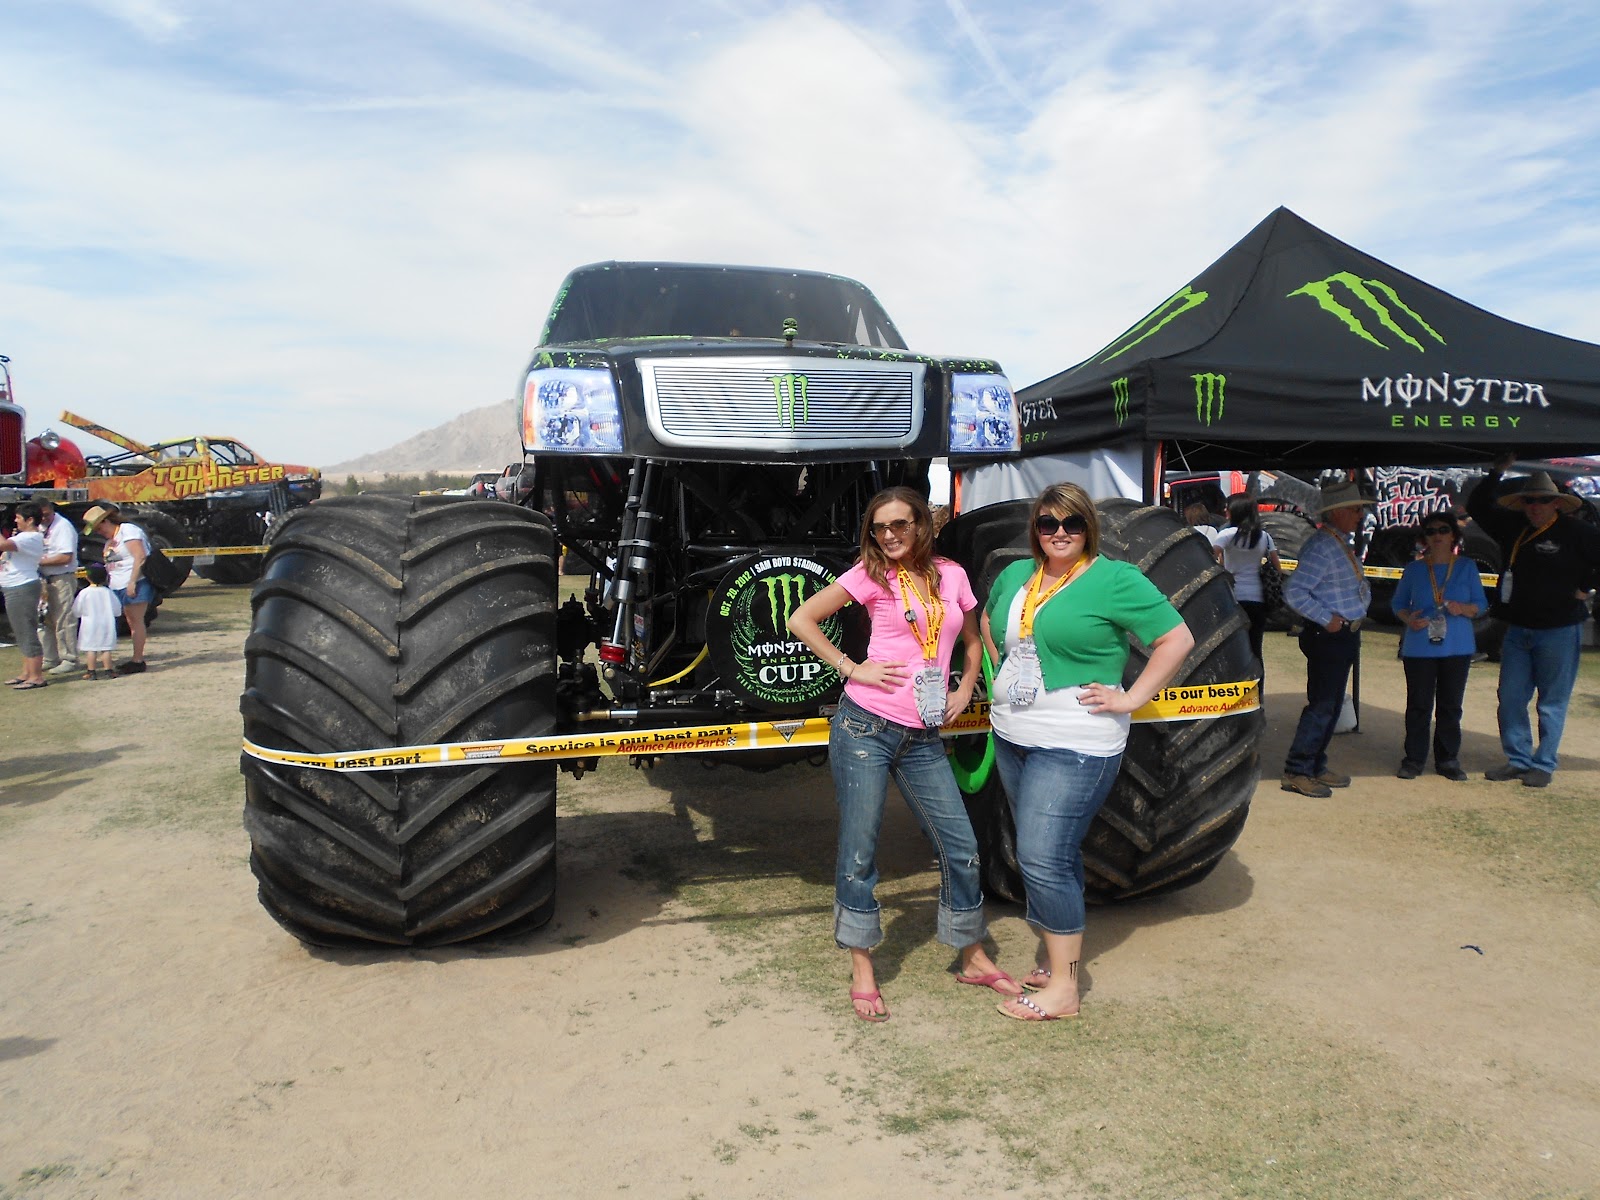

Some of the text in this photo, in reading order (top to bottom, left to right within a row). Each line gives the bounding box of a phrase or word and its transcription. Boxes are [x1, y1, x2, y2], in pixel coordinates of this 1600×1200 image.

[1362, 372, 1550, 408] MONSTER
[1391, 415, 1521, 428] ENERGY
[1024, 431, 1048, 443] RGY
[720, 557, 837, 617] OCT. 20, 2012 SAM BOYD STADIUM LA
[747, 641, 812, 657] MONST
[761, 655, 816, 664] ENERGY
[759, 662, 821, 684] CUP
[736, 671, 840, 703] THE MONSTER MILLIO
[1164, 687, 1177, 701] is
[1180, 688, 1204, 700] our
[1208, 685, 1240, 698] best
[1178, 704, 1219, 714] Advance
[526, 741, 596, 754] Service
[600, 738, 616, 747] is
[620, 736, 648, 745] our
[653, 731, 692, 742] best
[616, 737, 726, 754] Advance Auto Parts
